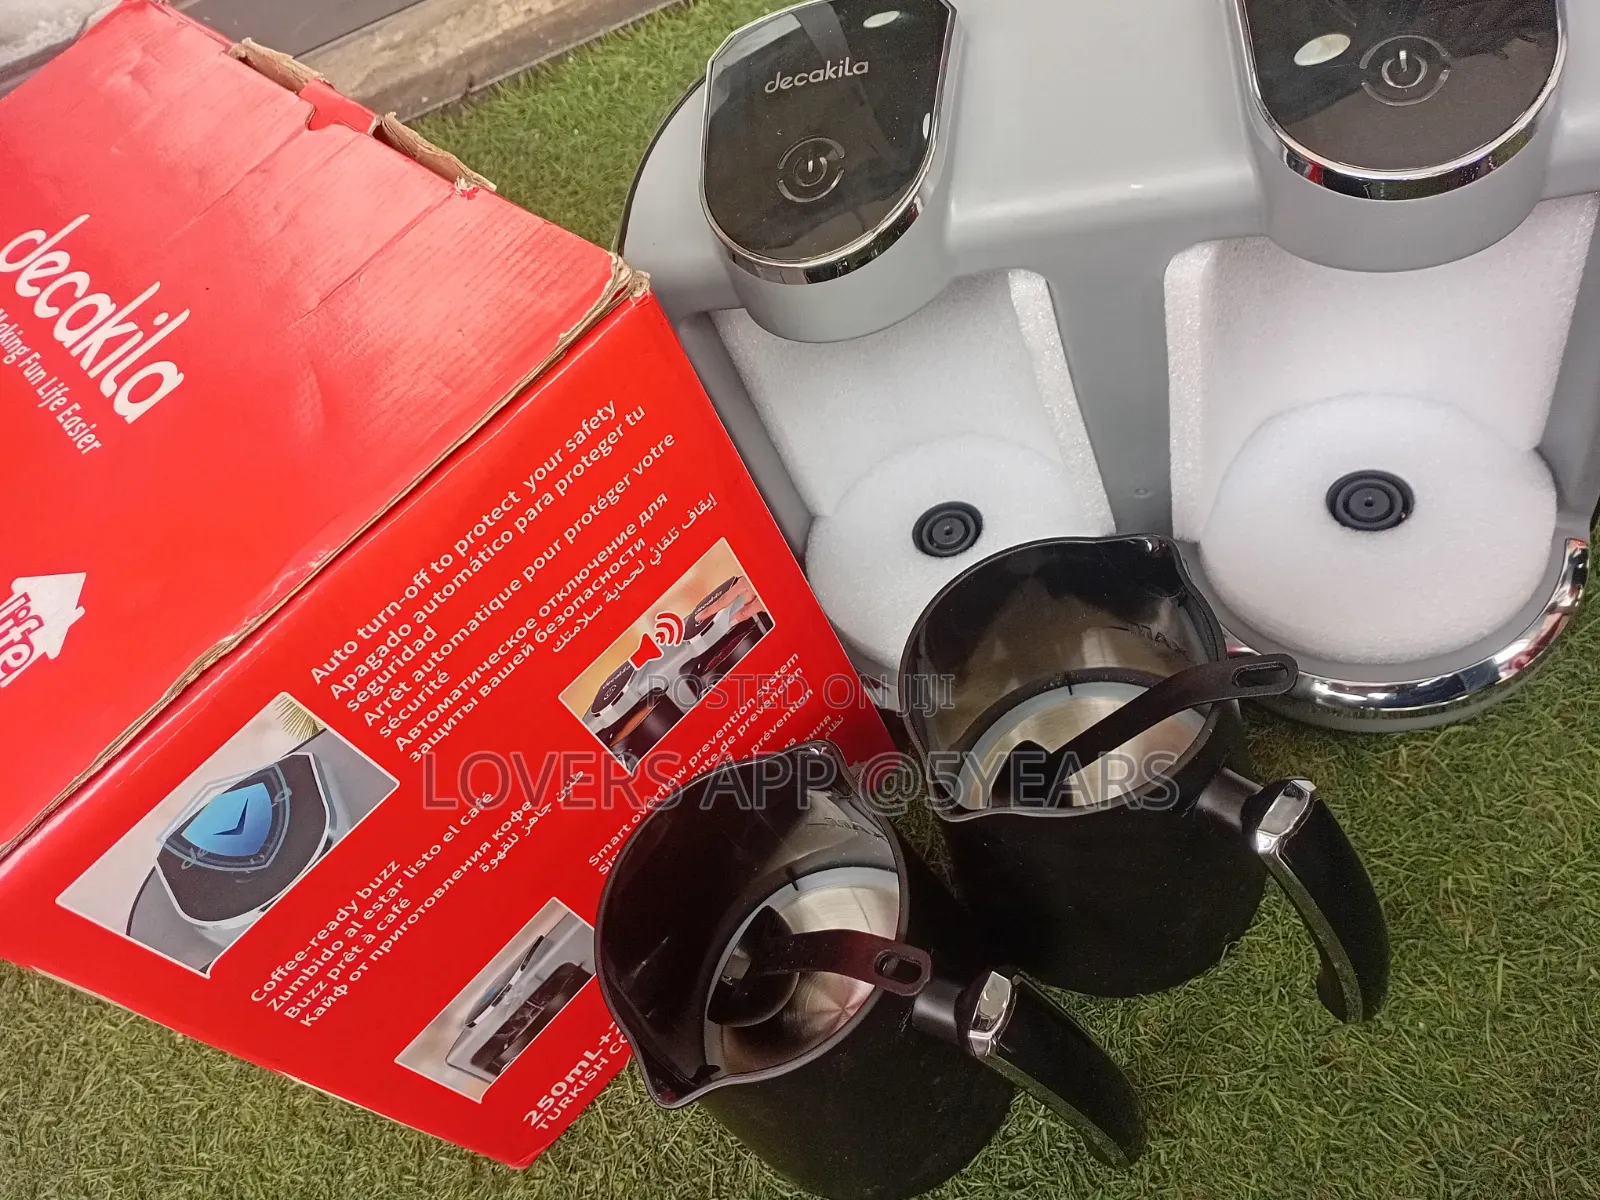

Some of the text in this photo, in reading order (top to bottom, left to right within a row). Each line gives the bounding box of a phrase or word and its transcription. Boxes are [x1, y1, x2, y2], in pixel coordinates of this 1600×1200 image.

[765, 57, 869, 93] decakila
[0, 214, 190, 424] decakila
[17, 352, 47, 385] Fun
[36, 376, 70, 411] Life
[56, 402, 102, 454] Easier
[311, 401, 617, 684] Auto turn-off to protect your safety
[330, 405, 645, 699] Apagado automático para proteger tu
[364, 432, 675, 726] Arrêt automatique pour protéger votre
[395, 494, 668, 752] Автоматическое отключение для
[347, 624, 438, 713] seguridad
[379, 669, 451, 738] sécurité
[409, 537, 645, 763] защиты вашей безопасности
[720, 667, 803, 754] de prevención
[750, 688, 814, 755] prévention
[588, 824, 631, 866] Smart
[632, 766, 687, 823] overflow
[689, 697, 756, 768] prevention
[757, 652, 799, 697] system
[251, 860, 401, 1002] Coffee-ready buzz
[268, 791, 494, 1011] Zumbido al estar listo el café
[284, 897, 411, 1018] Buzz prêt à café
[300, 800, 533, 1027] Кайф от приготовления кофе
[536, 1057, 609, 1130] TURKISH
